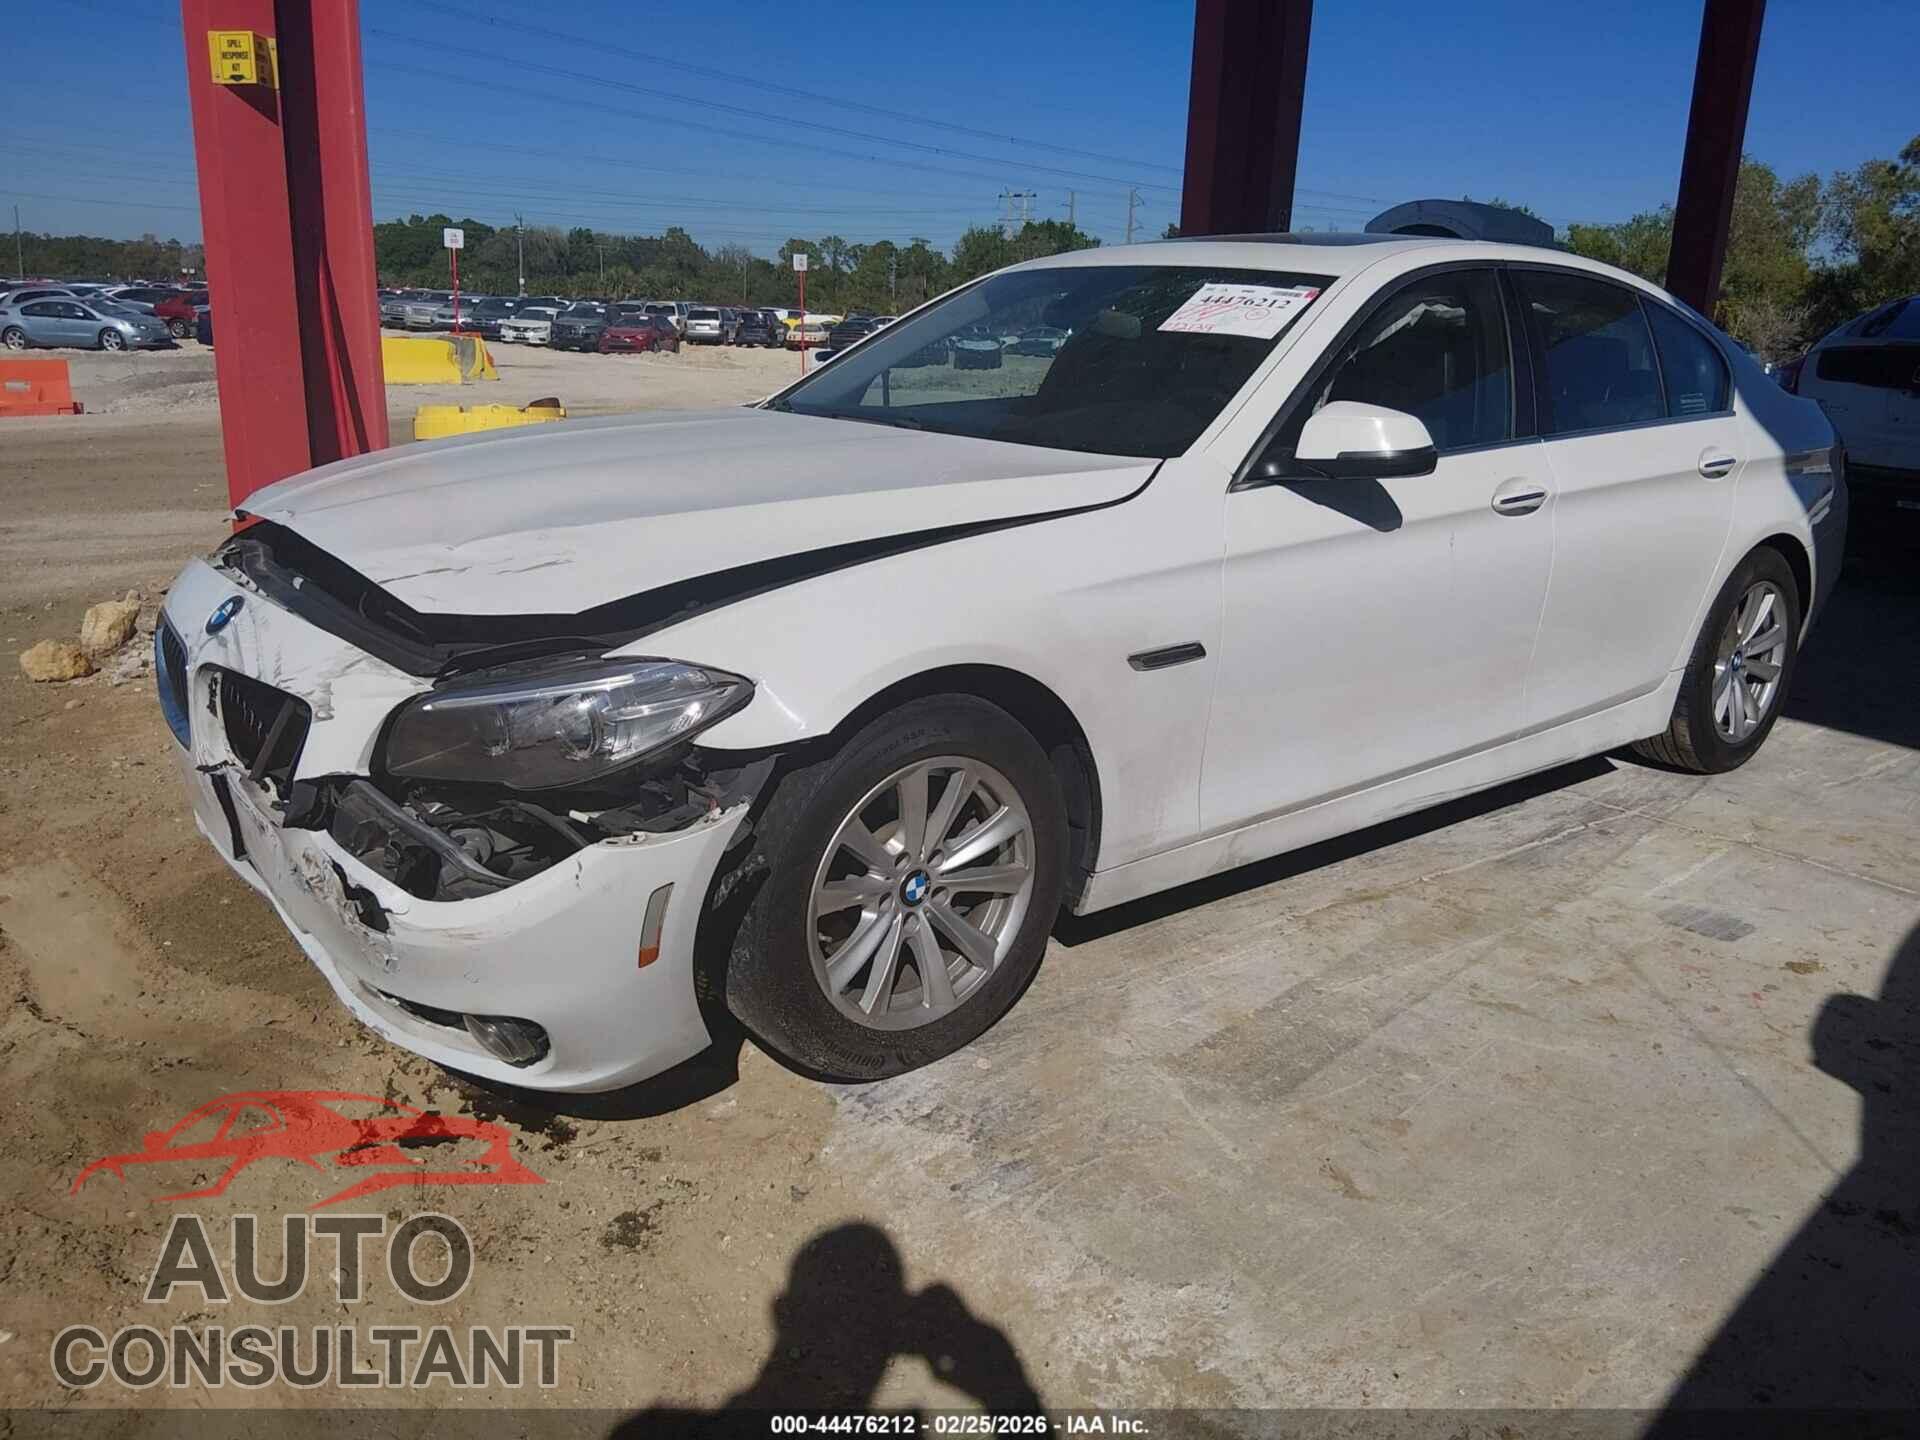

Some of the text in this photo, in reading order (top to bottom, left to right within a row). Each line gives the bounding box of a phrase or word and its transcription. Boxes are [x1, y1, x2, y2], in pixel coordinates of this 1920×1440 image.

[226, 39, 242, 49] SPILL
[222, 51, 249, 60] RESPONSE
[231, 62, 241, 72] KIT
[1201, 295, 1291, 309] 44476212
